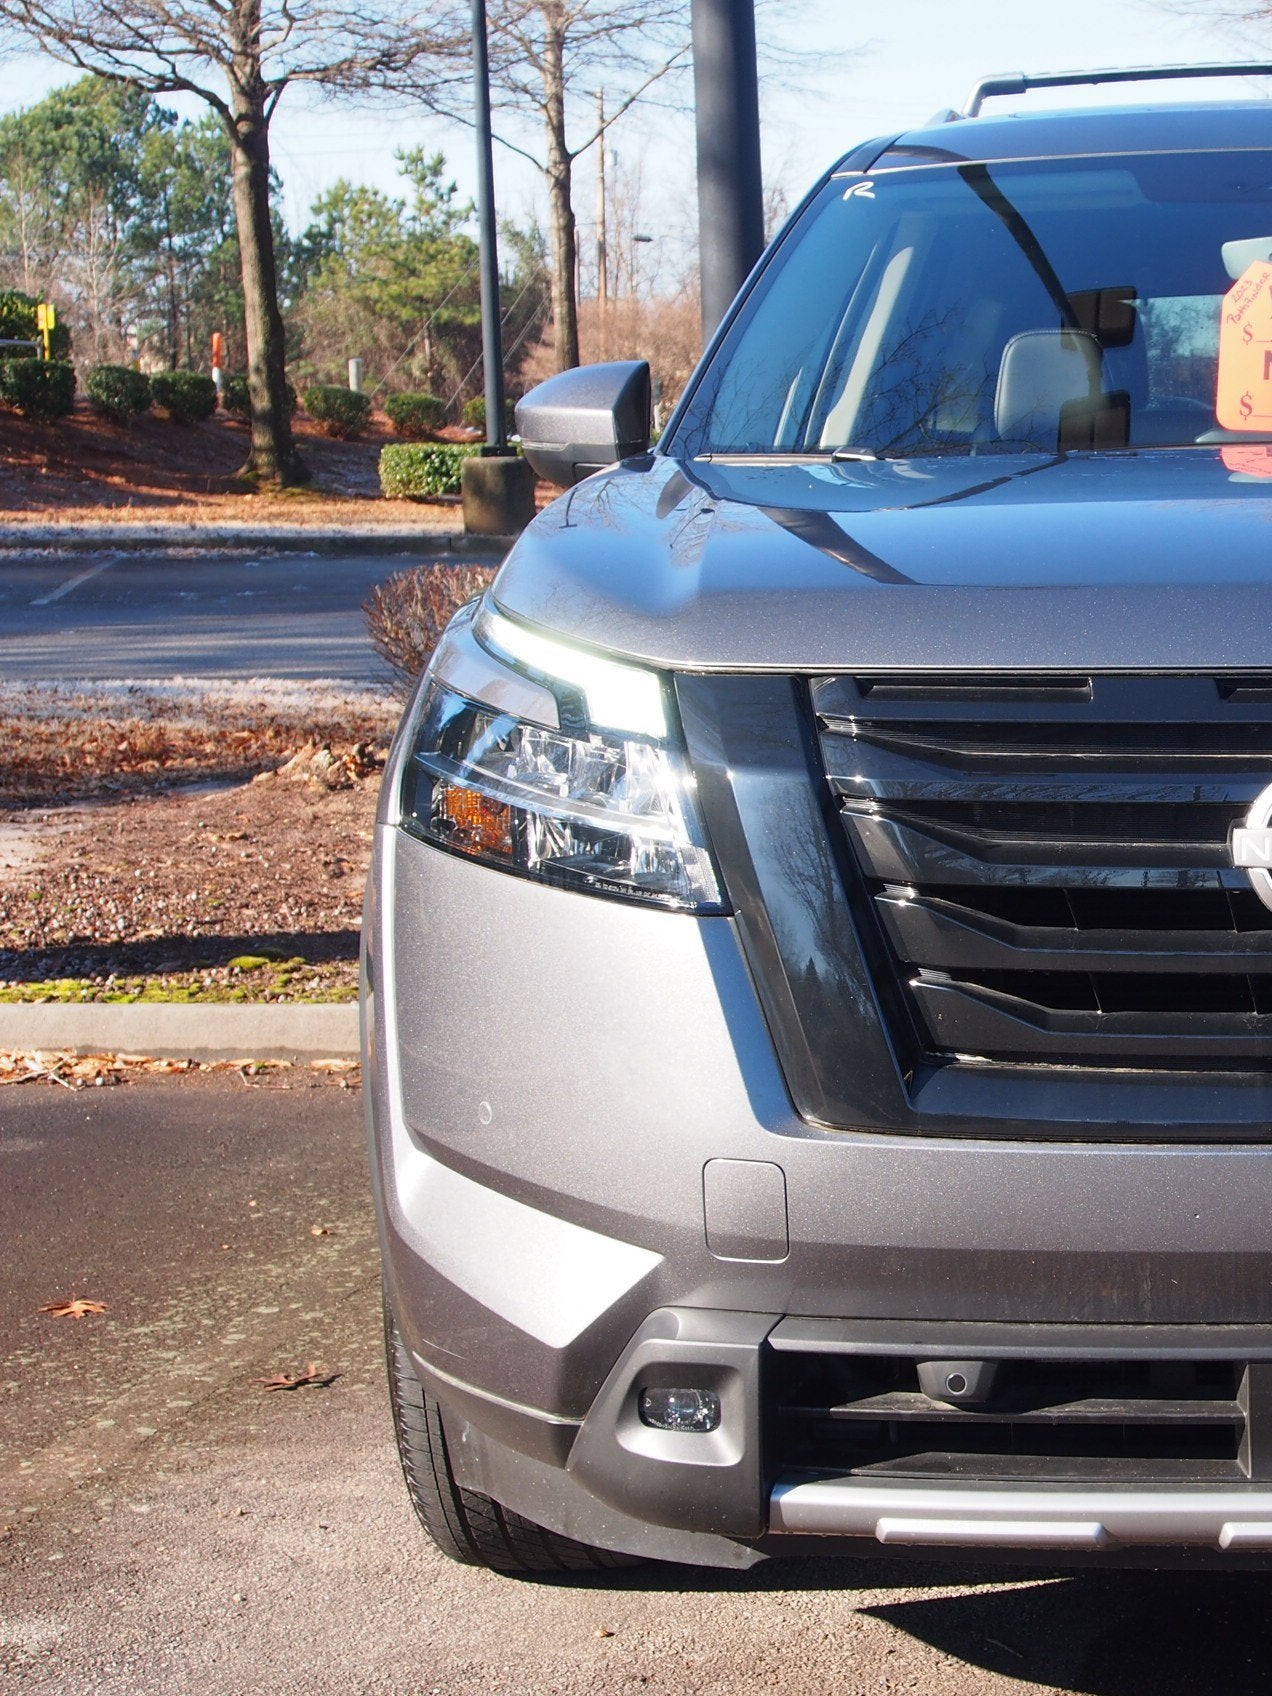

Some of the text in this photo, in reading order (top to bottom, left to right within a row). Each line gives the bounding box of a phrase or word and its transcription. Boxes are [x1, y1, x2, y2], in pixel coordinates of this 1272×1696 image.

[1231, 279, 1253, 304] 2023
[1242, 322, 1253, 345] $
[1240, 391, 1253, 420] $
